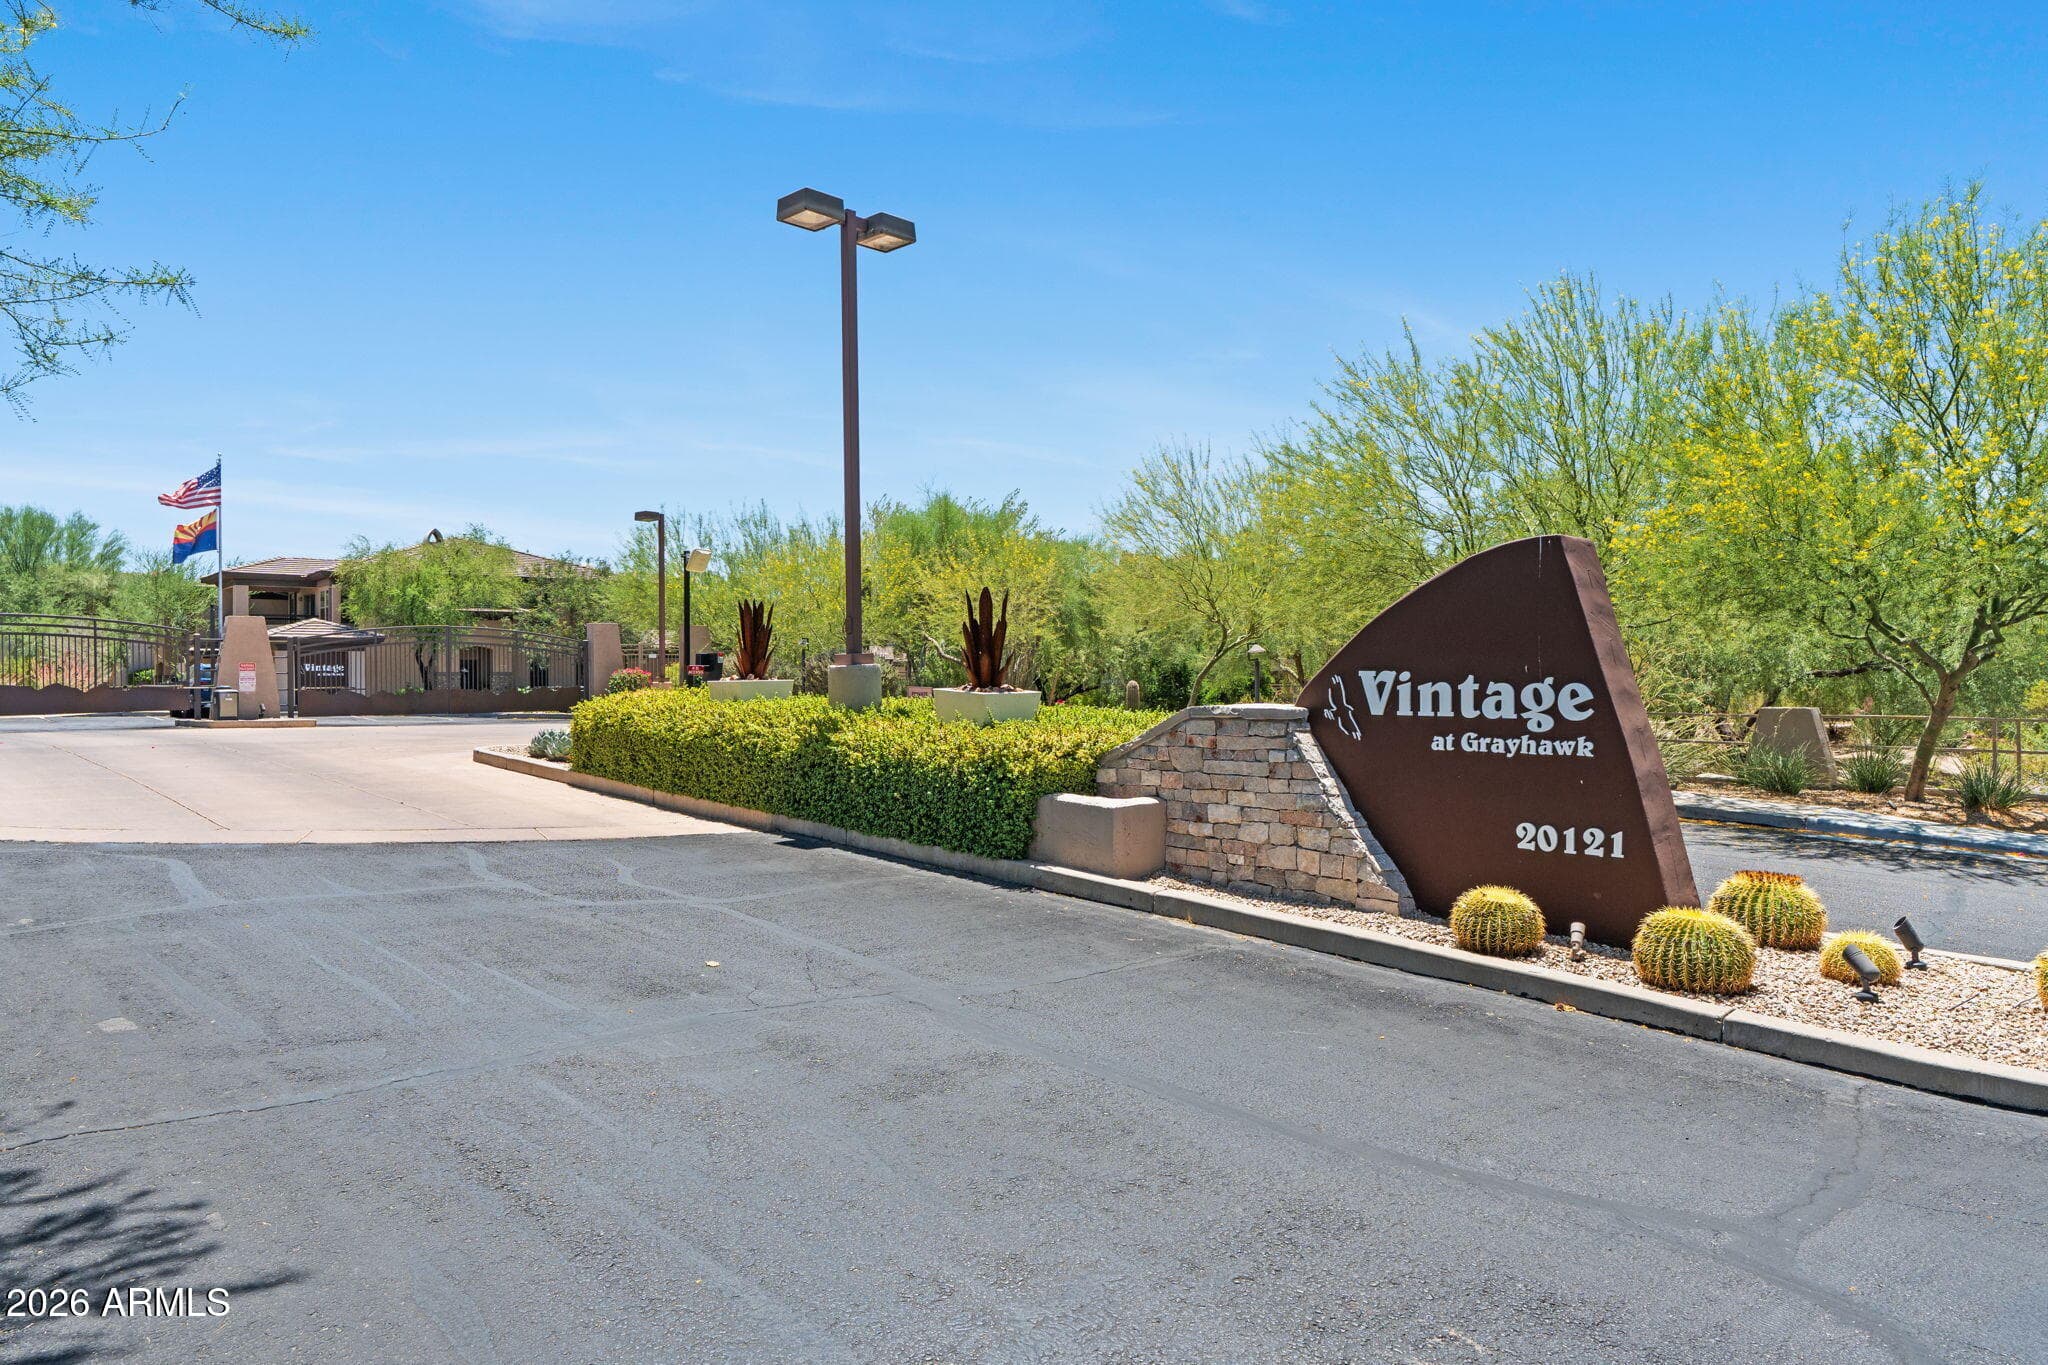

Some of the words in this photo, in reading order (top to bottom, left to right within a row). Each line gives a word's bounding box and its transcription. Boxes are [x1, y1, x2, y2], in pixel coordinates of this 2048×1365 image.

[1358, 669, 1595, 733] Vintage
[1431, 733, 1455, 751] at
[1461, 731, 1595, 758] Grayhawk
[1515, 822, 1625, 859] 20121
